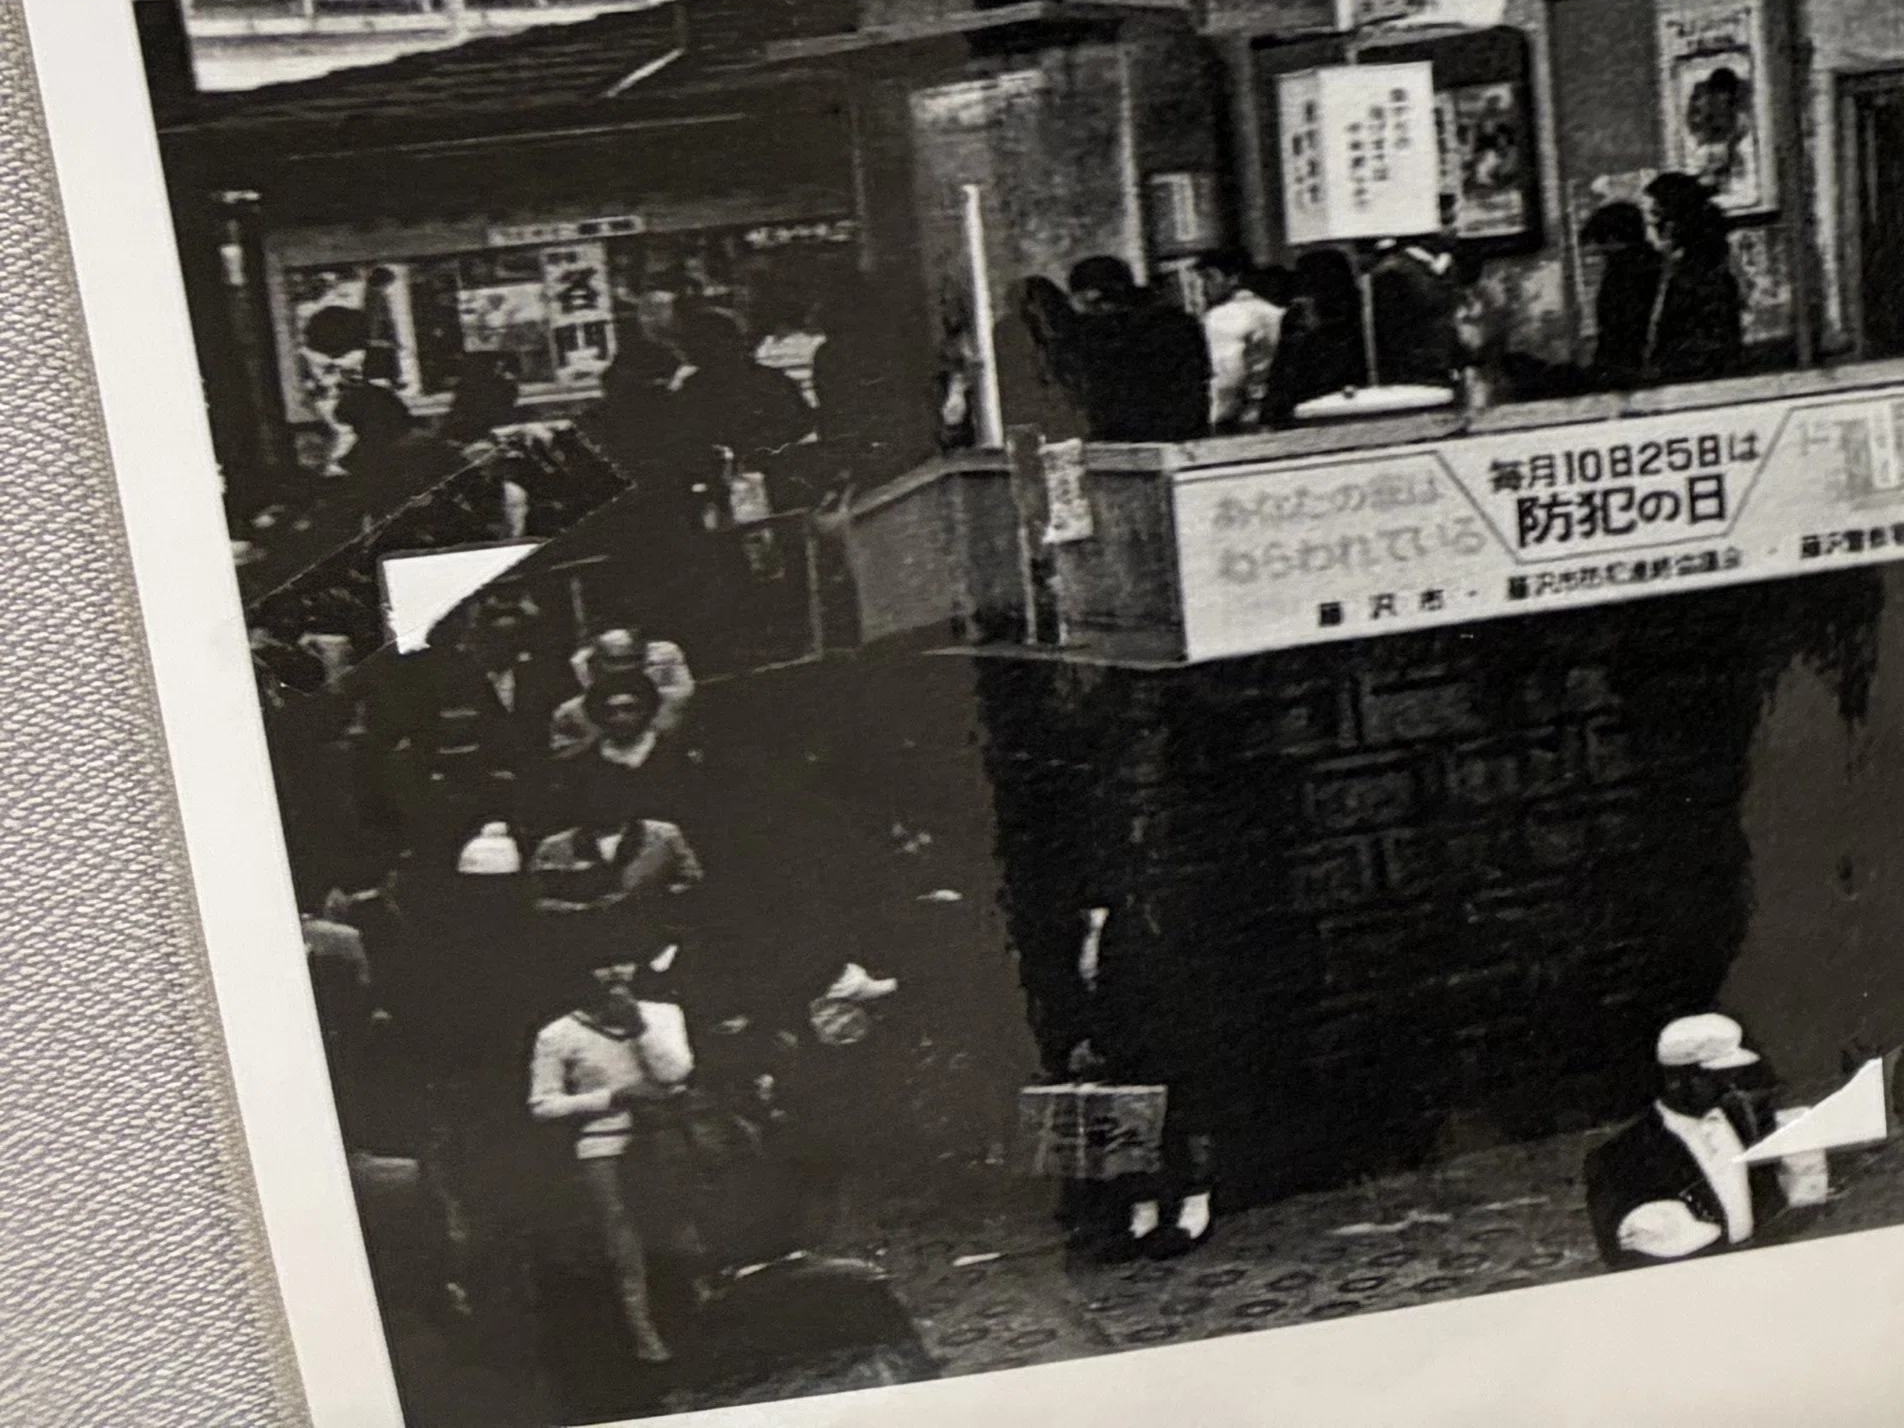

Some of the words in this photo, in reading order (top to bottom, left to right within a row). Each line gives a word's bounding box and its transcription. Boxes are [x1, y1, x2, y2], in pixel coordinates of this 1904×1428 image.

[1488, 431, 1761, 493] 毎月10日25日は
[1516, 473, 1727, 549] 防犯の日
